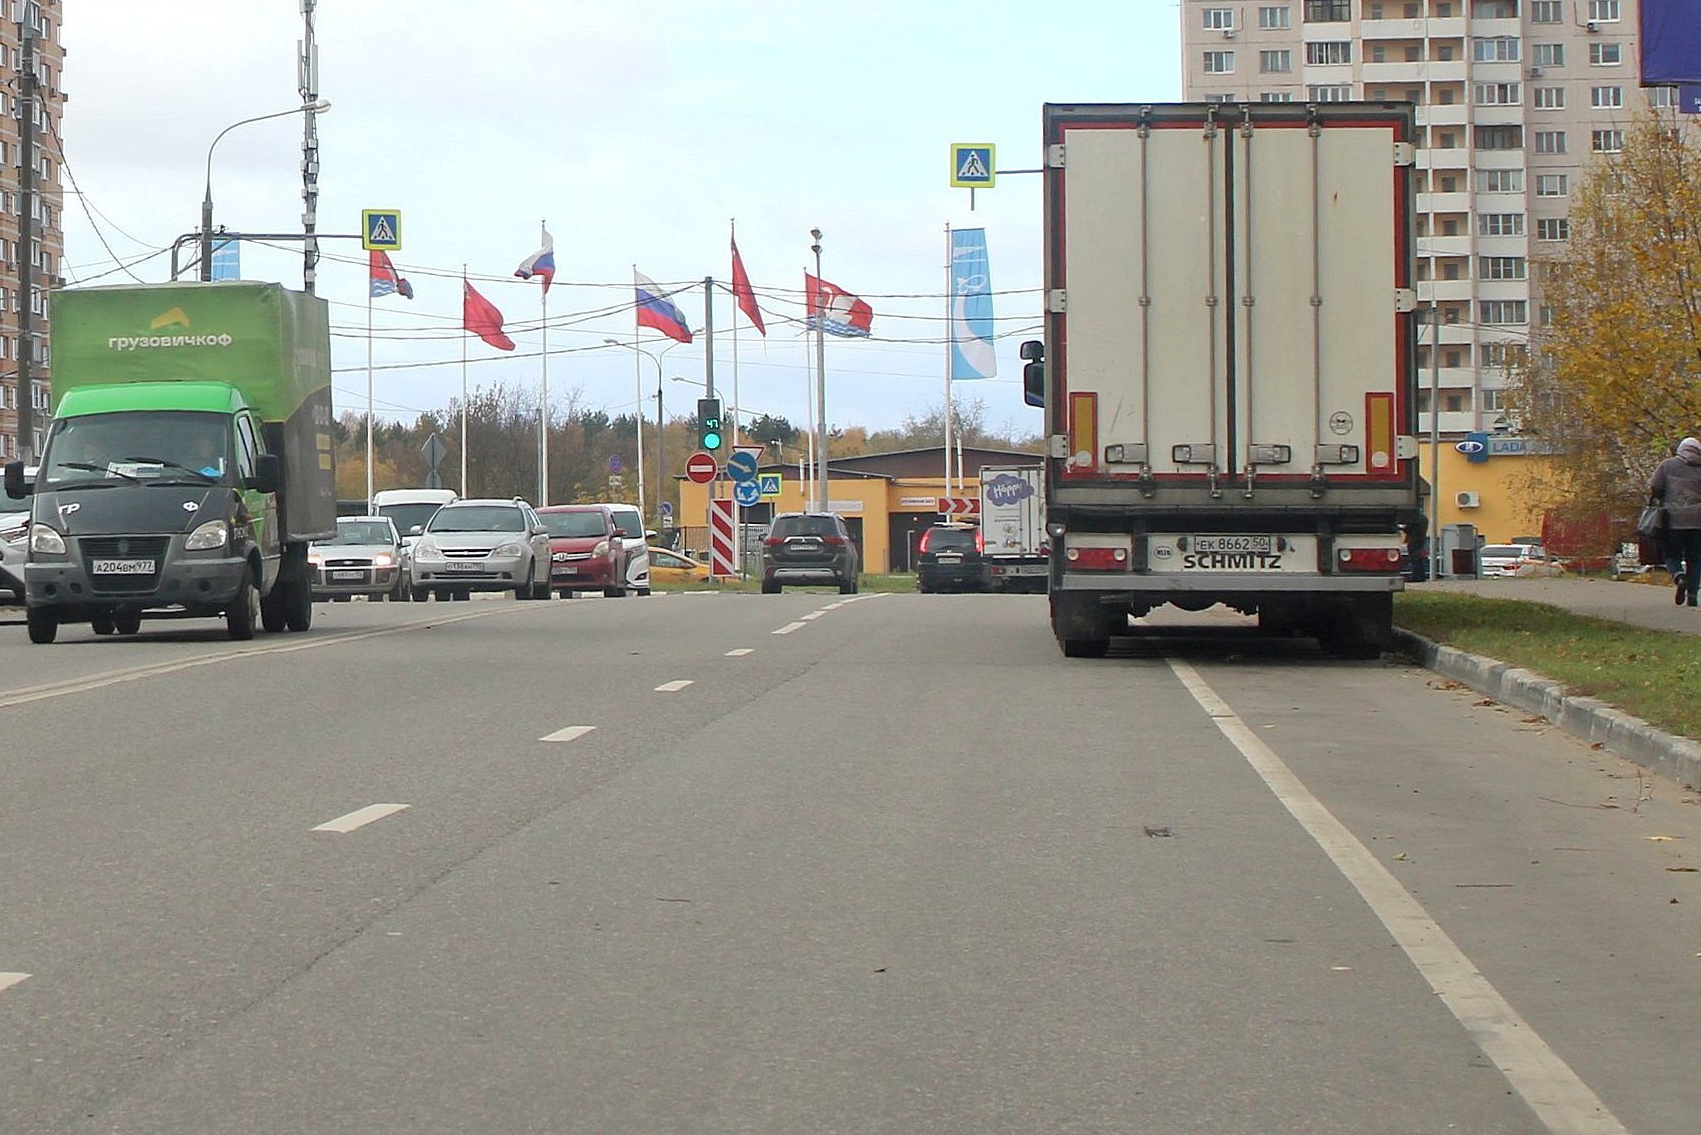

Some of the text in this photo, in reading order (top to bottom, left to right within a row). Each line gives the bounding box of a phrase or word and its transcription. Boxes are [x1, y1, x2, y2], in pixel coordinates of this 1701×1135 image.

[706, 419, 719, 429] 47
[1492, 442, 1528, 453] LADA
[1218, 538, 1250, 550] 8662
[1253, 537, 1266, 547] 50
[1184, 553, 1282, 569] SCHMITZ
